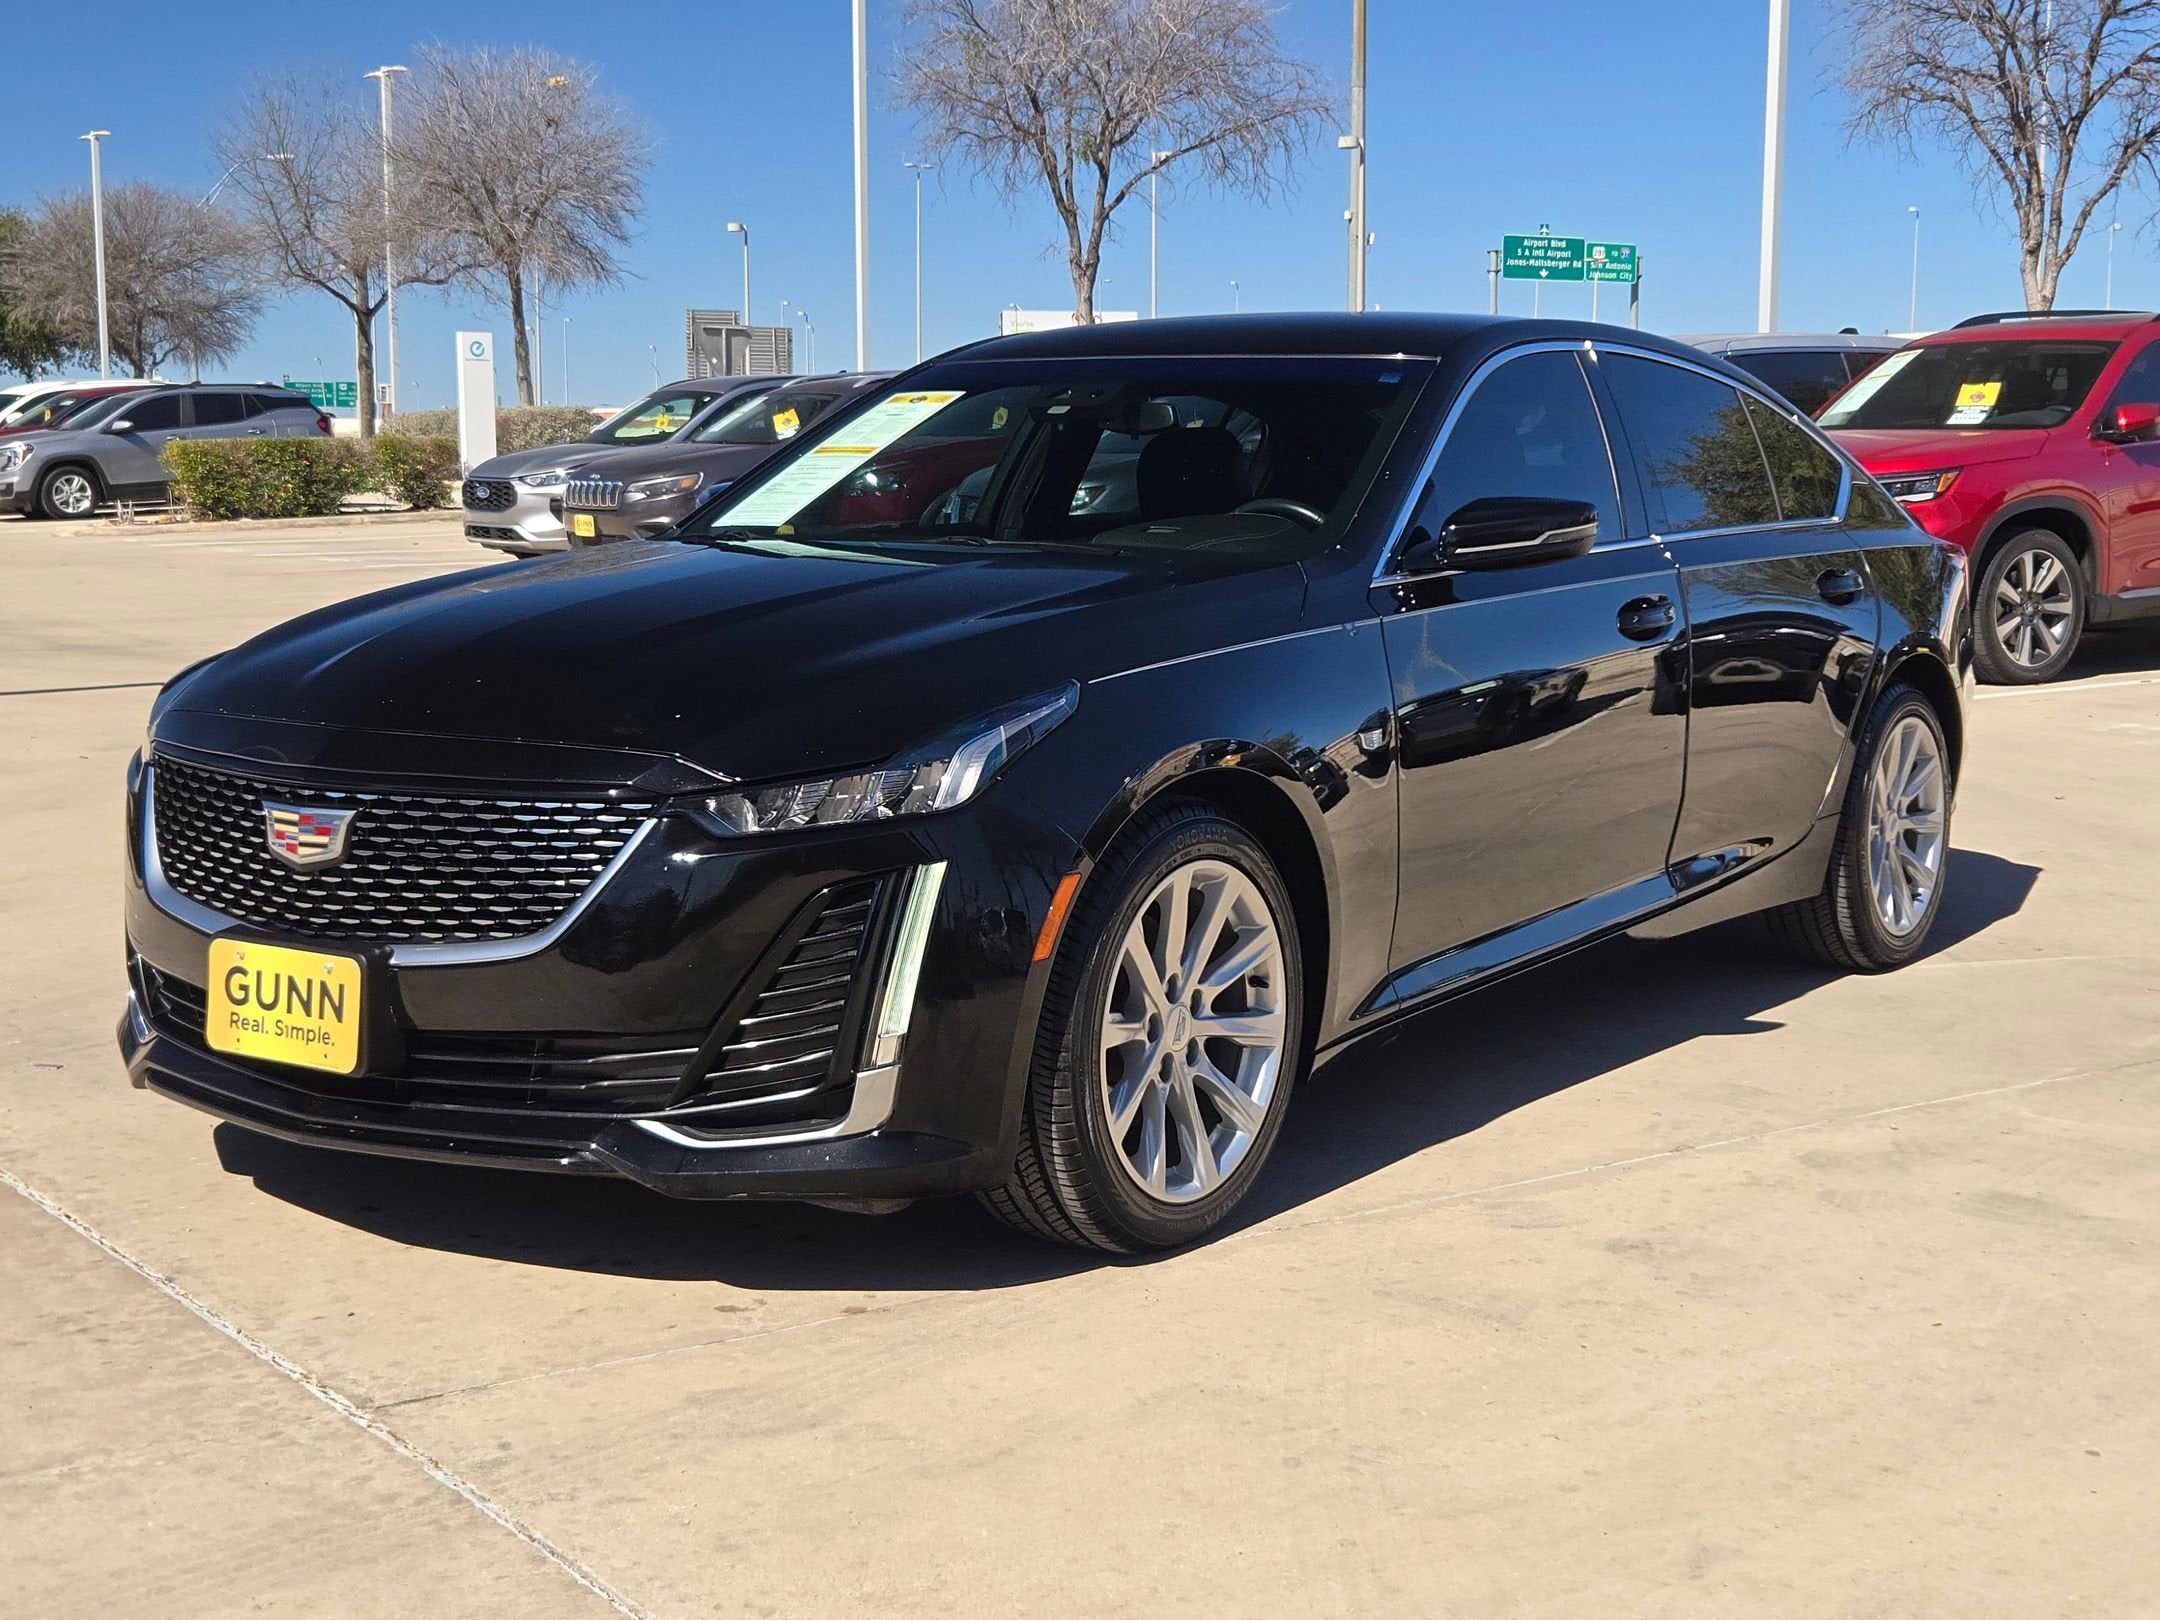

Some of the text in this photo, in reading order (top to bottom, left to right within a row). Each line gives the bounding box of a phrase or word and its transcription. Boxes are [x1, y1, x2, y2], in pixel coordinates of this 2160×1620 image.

[1523, 239, 1567, 248] Airport Blvd
[1517, 248, 1522, 256] S
[1532, 249, 1545, 257] Intl
[1547, 250, 1572, 259] Airport
[1506, 258, 1583, 269] Jones-Maltsberger Rd
[1605, 262, 1632, 270] Antonio
[1589, 271, 1633, 281] Johnson City
[224, 965, 345, 1024] GUNN
[229, 1011, 269, 1035] Real.
